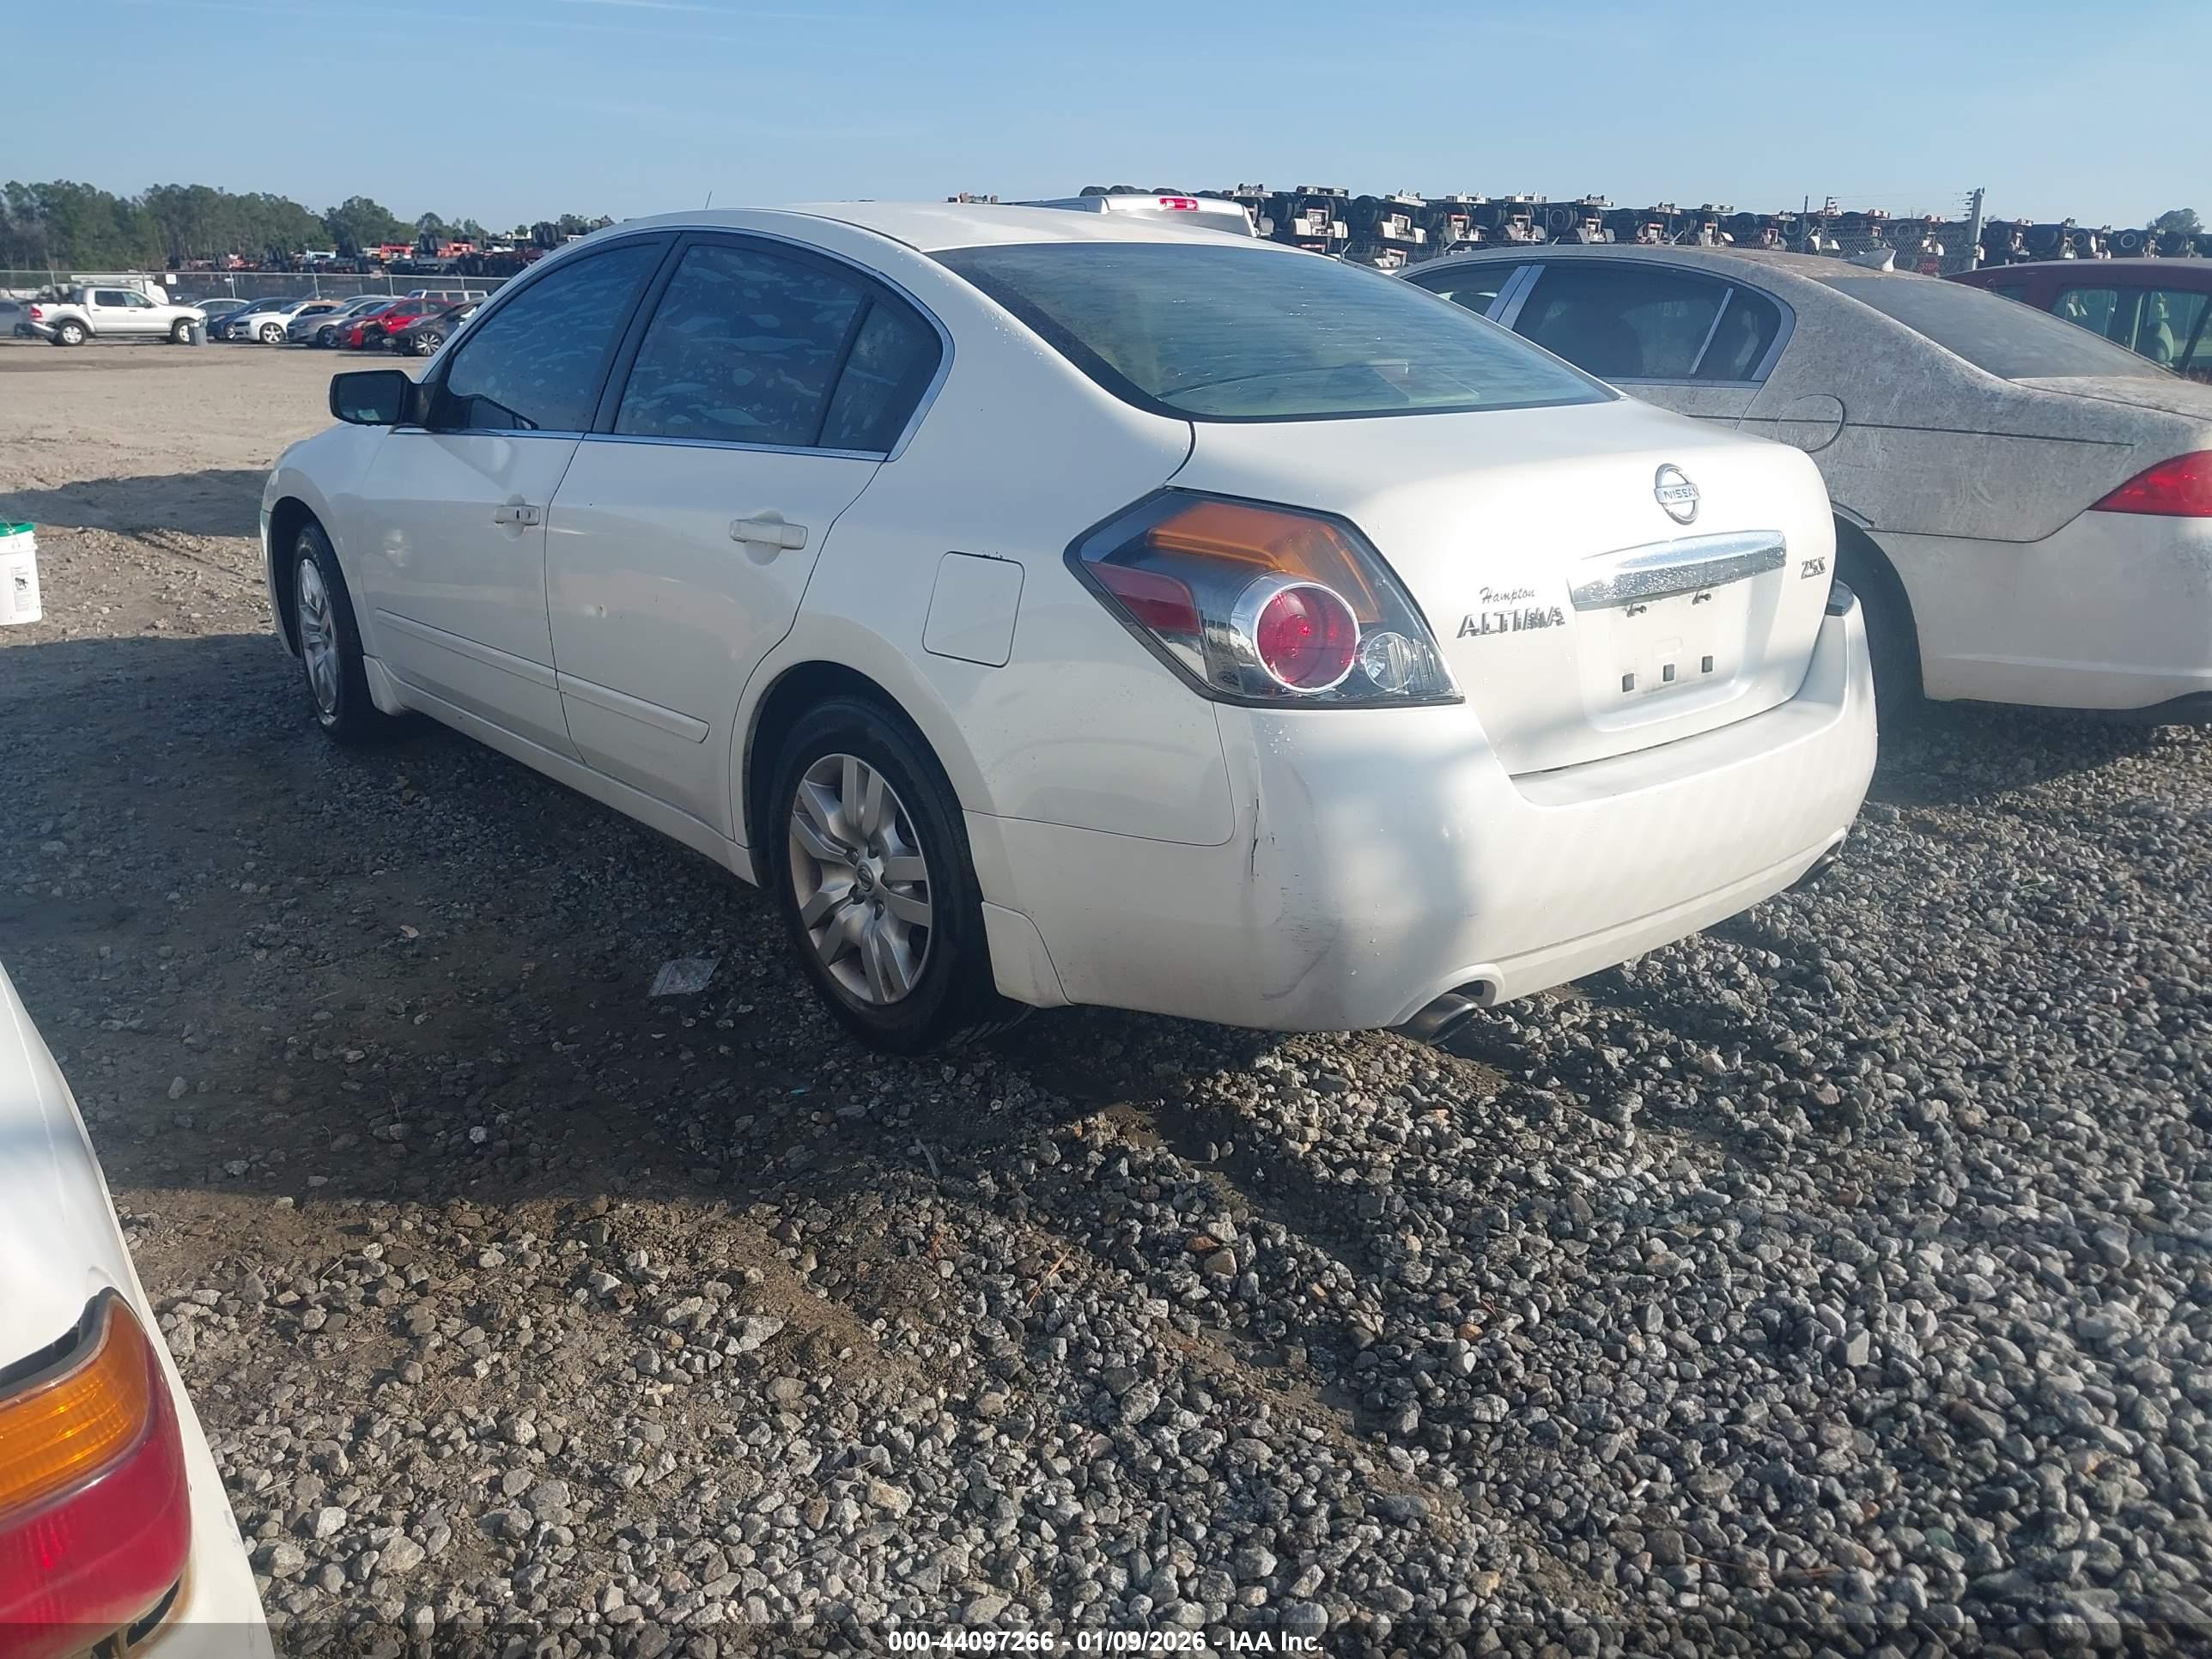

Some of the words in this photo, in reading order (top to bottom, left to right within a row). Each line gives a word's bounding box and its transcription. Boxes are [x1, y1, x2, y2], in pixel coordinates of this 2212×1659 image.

[1662, 485, 1698, 500] NISSAN
[1479, 586, 1535, 605] Hampton
[1456, 605, 1566, 638] ALTIMA
